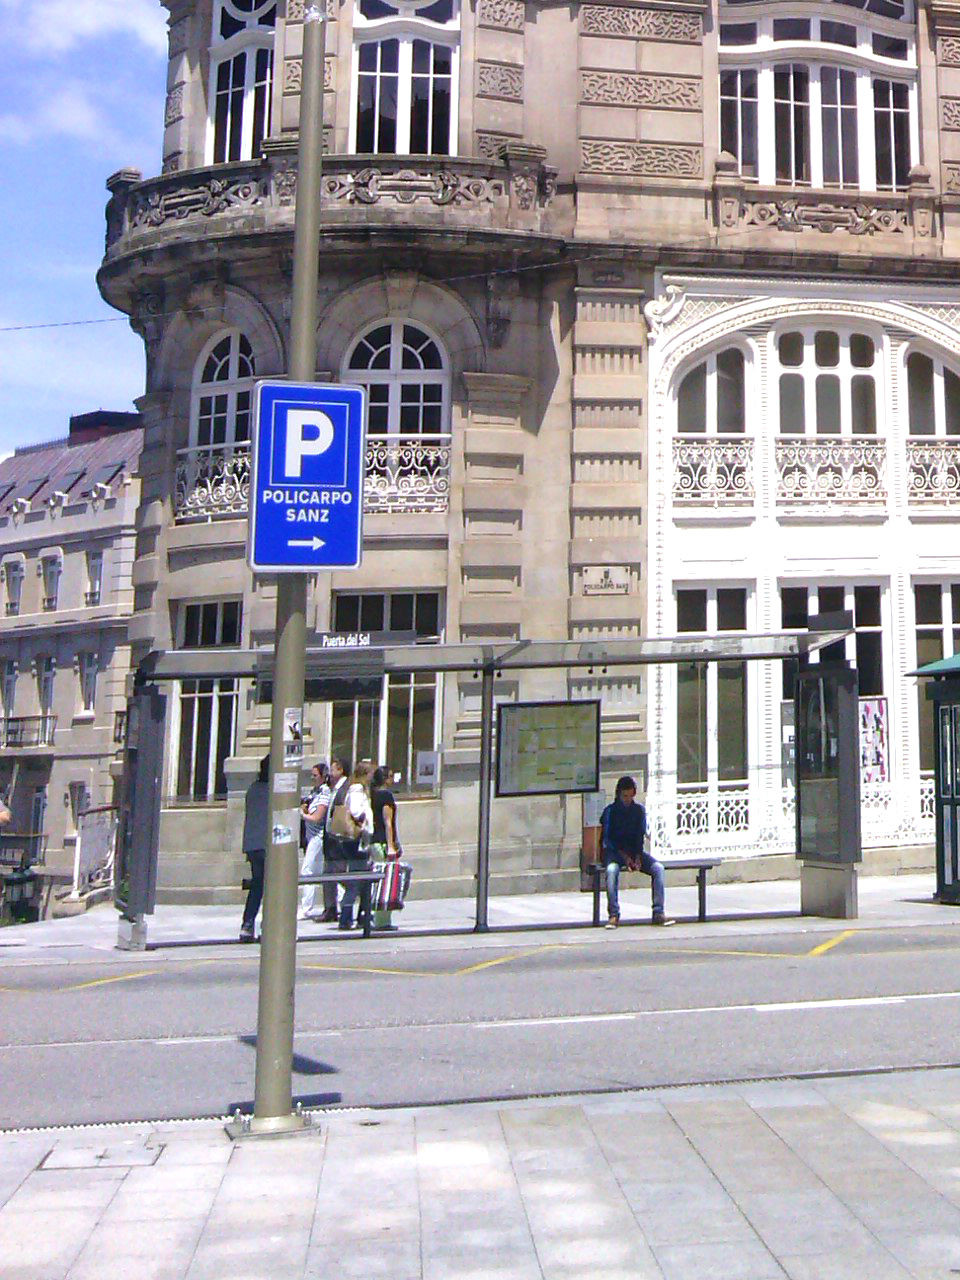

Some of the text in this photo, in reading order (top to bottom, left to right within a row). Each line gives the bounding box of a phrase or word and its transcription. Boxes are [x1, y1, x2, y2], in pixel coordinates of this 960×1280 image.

[284, 409, 335, 478] P
[262, 490, 352, 505] POLICARPO
[286, 508, 330, 523] SANZ
[322, 633, 370, 647] Puerta del Sol
